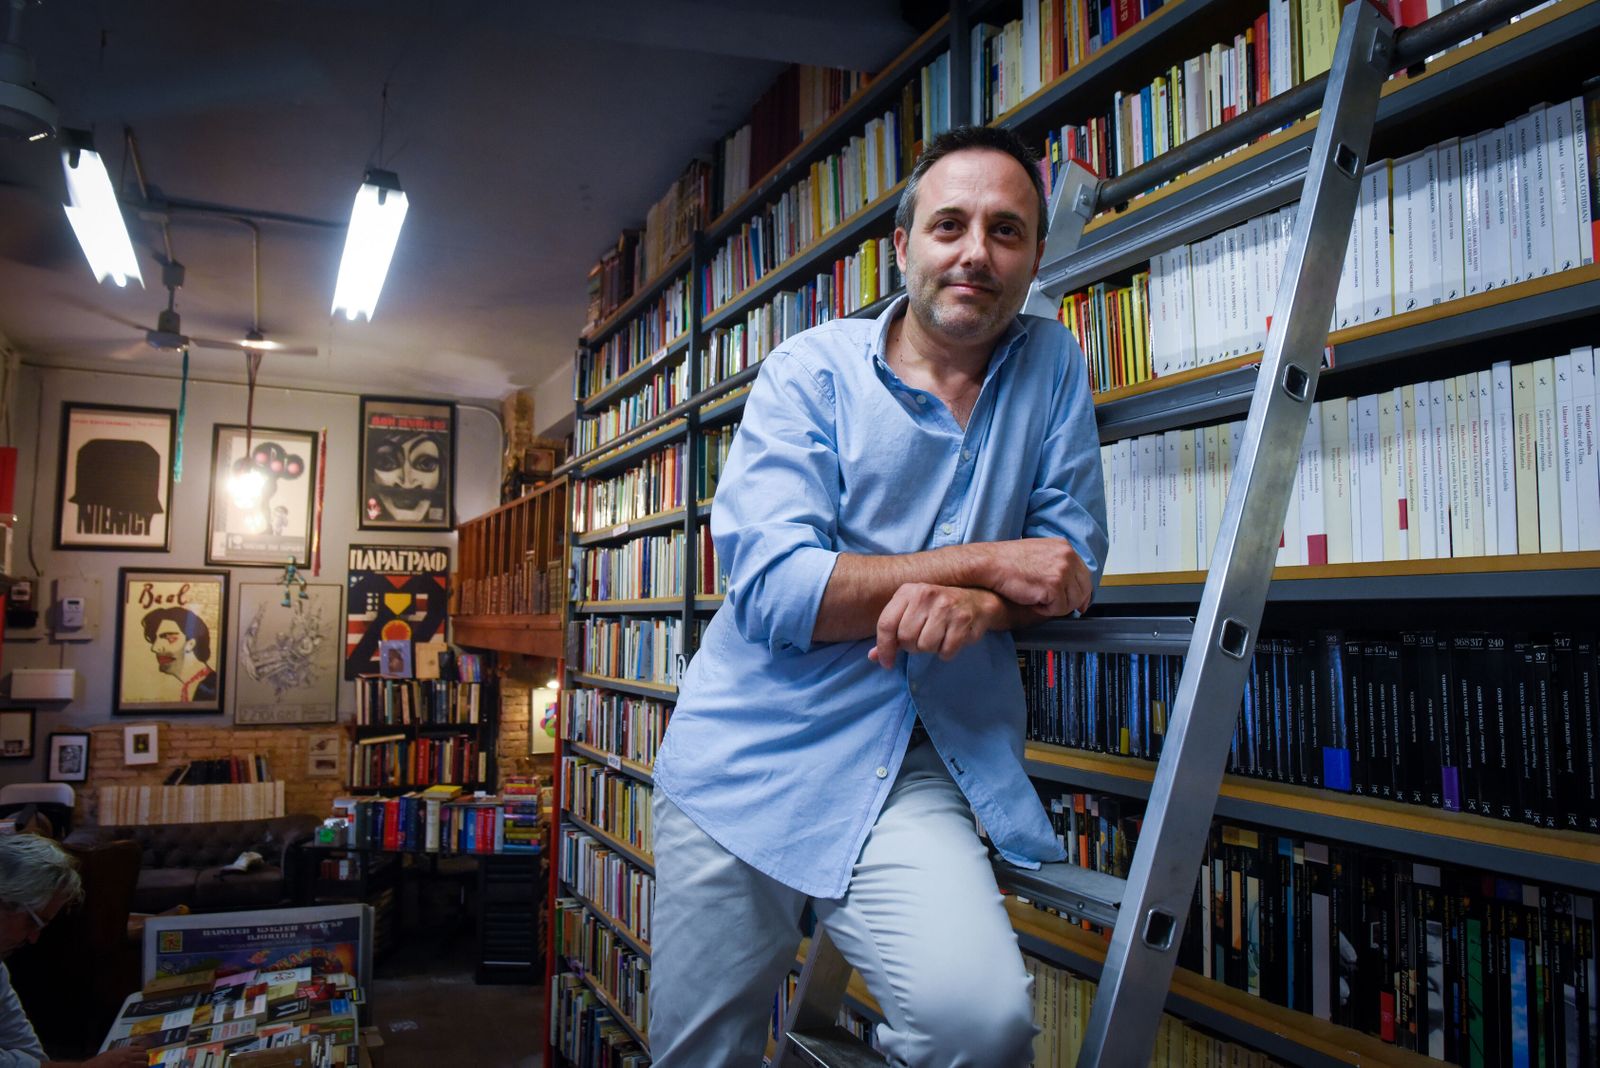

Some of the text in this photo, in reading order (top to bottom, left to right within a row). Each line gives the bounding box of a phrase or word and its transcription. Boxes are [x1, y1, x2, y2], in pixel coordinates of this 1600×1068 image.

[1577, 162, 1586, 183] NADA
[1579, 184, 1589, 224] COTIDIANA
[1575, 413, 1584, 439] síndrome
[1583, 405, 1594, 456] Santiago Gamboa
[1562, 439, 1570, 458] Mundo
[1576, 448, 1585, 465] Ulises
[1563, 458, 1571, 482] Mendoza
[349, 549, 447, 572] ПАРАГРАФ
[139, 583, 190, 609] Baal
[1488, 638, 1504, 648] 240
[1535, 652, 1547, 661] 37
